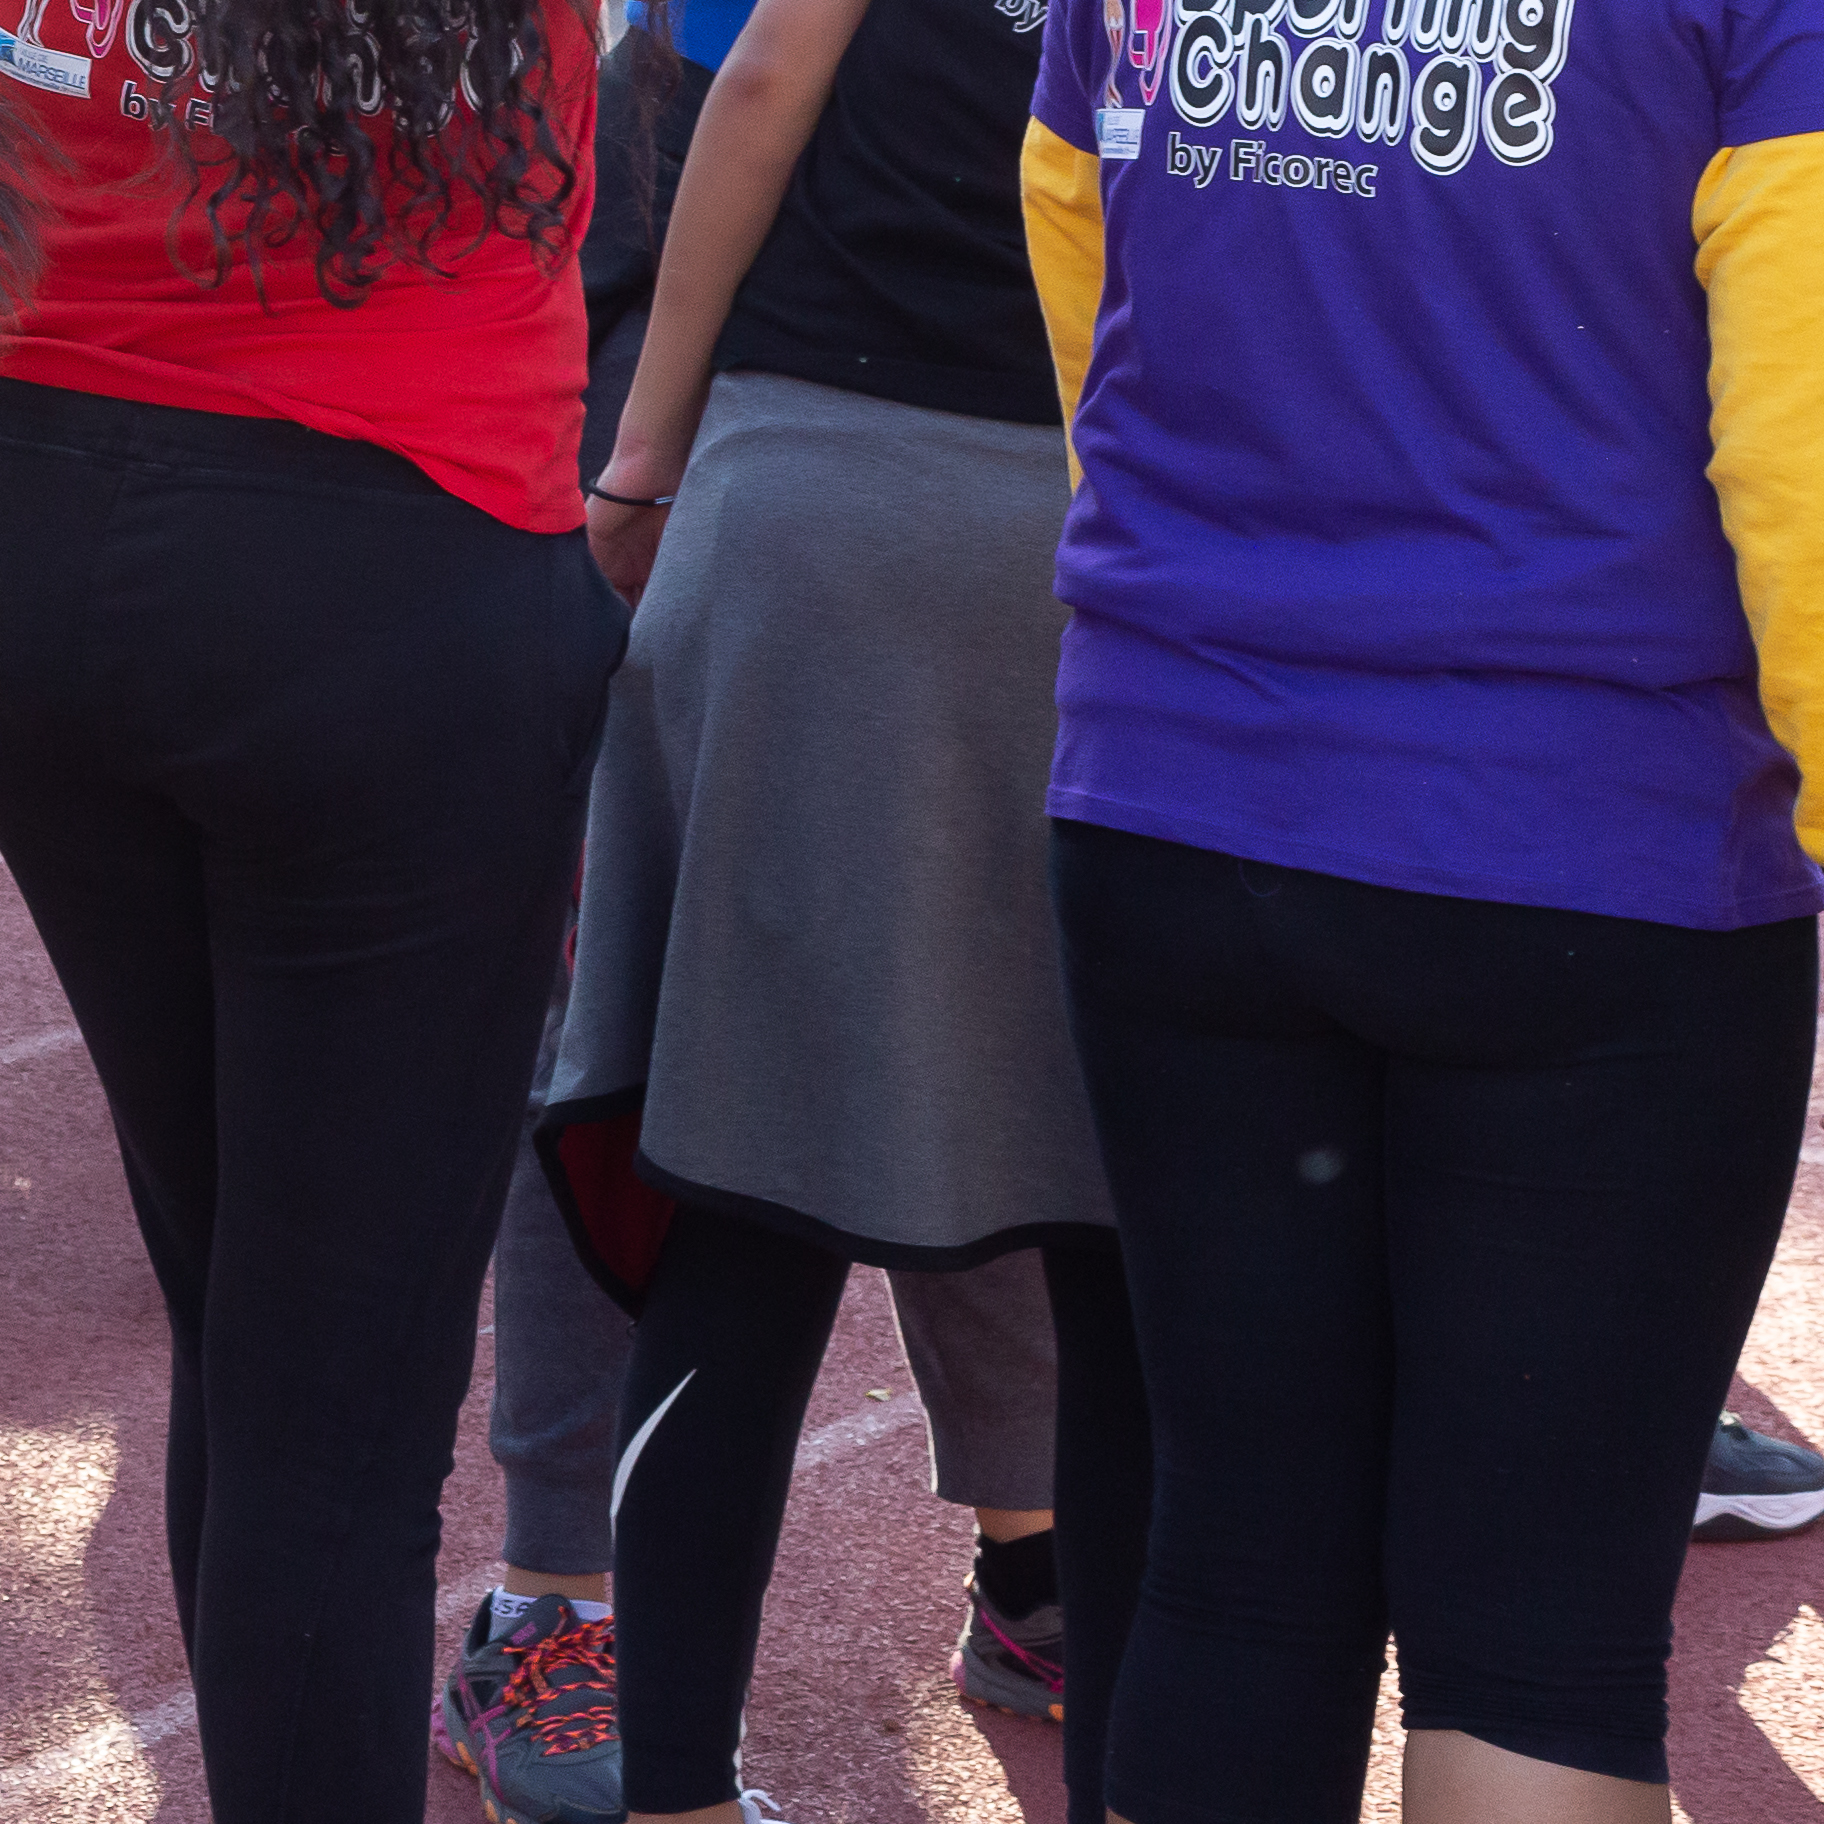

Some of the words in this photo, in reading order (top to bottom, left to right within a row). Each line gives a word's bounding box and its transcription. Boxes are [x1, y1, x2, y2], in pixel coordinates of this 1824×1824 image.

[1169, 10, 1556, 175] Change
[1166, 131, 1222, 188] by
[1229, 138, 1378, 198] Ficorec
